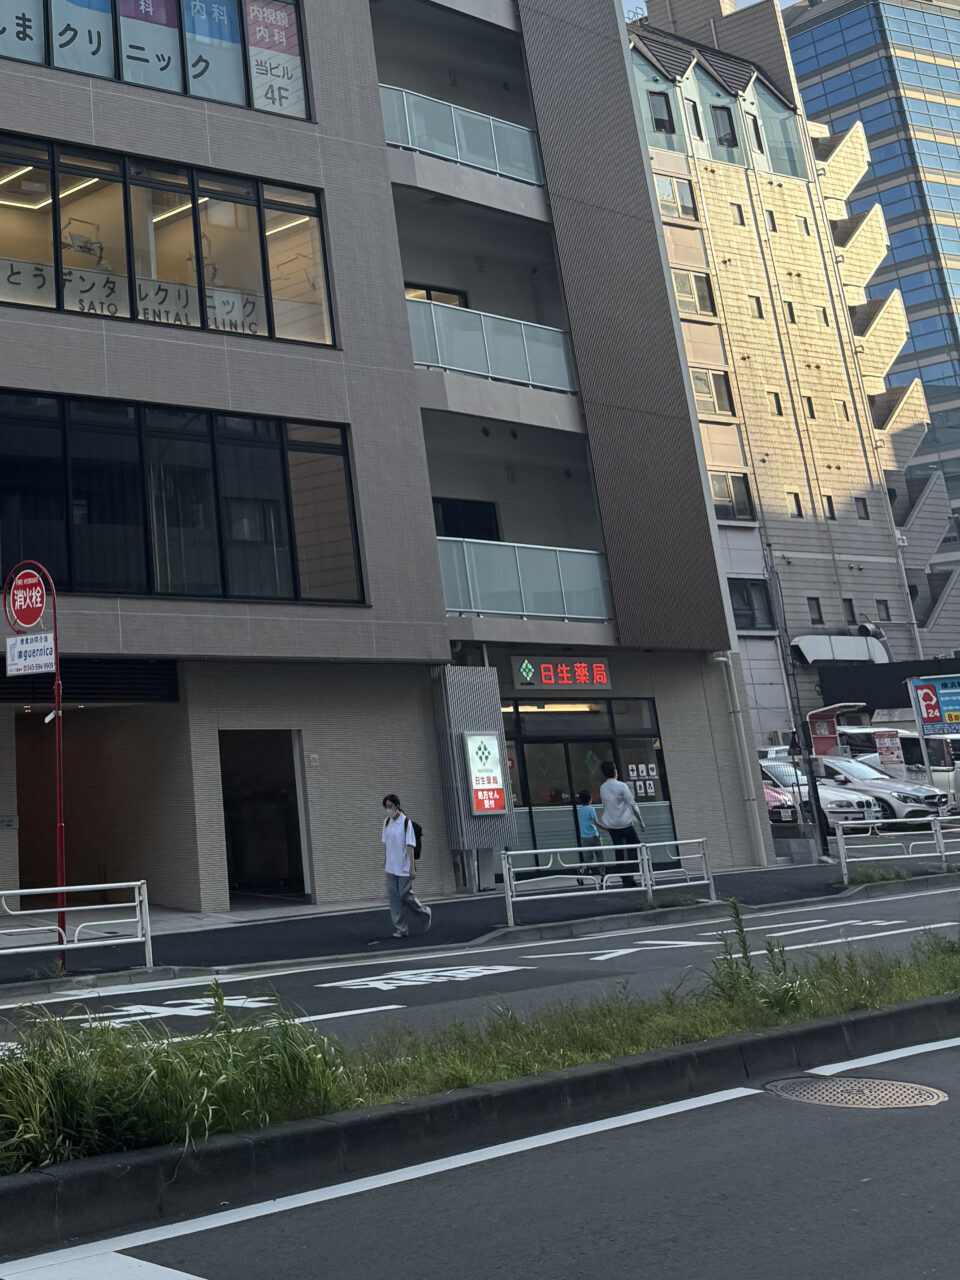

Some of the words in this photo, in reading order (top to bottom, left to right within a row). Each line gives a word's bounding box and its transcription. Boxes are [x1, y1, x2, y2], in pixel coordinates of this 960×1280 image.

[249, 3, 289, 30] 内視鏡
[255, 23, 288, 47] 内科
[254, 57, 294, 82] 当ビル
[264, 81, 290, 107] 4F
[78, 298, 118, 316] SATO
[137, 307, 191, 325] ENTAL
[14, 586, 43, 610] 消火栓
[928, 709, 940, 718] 24
